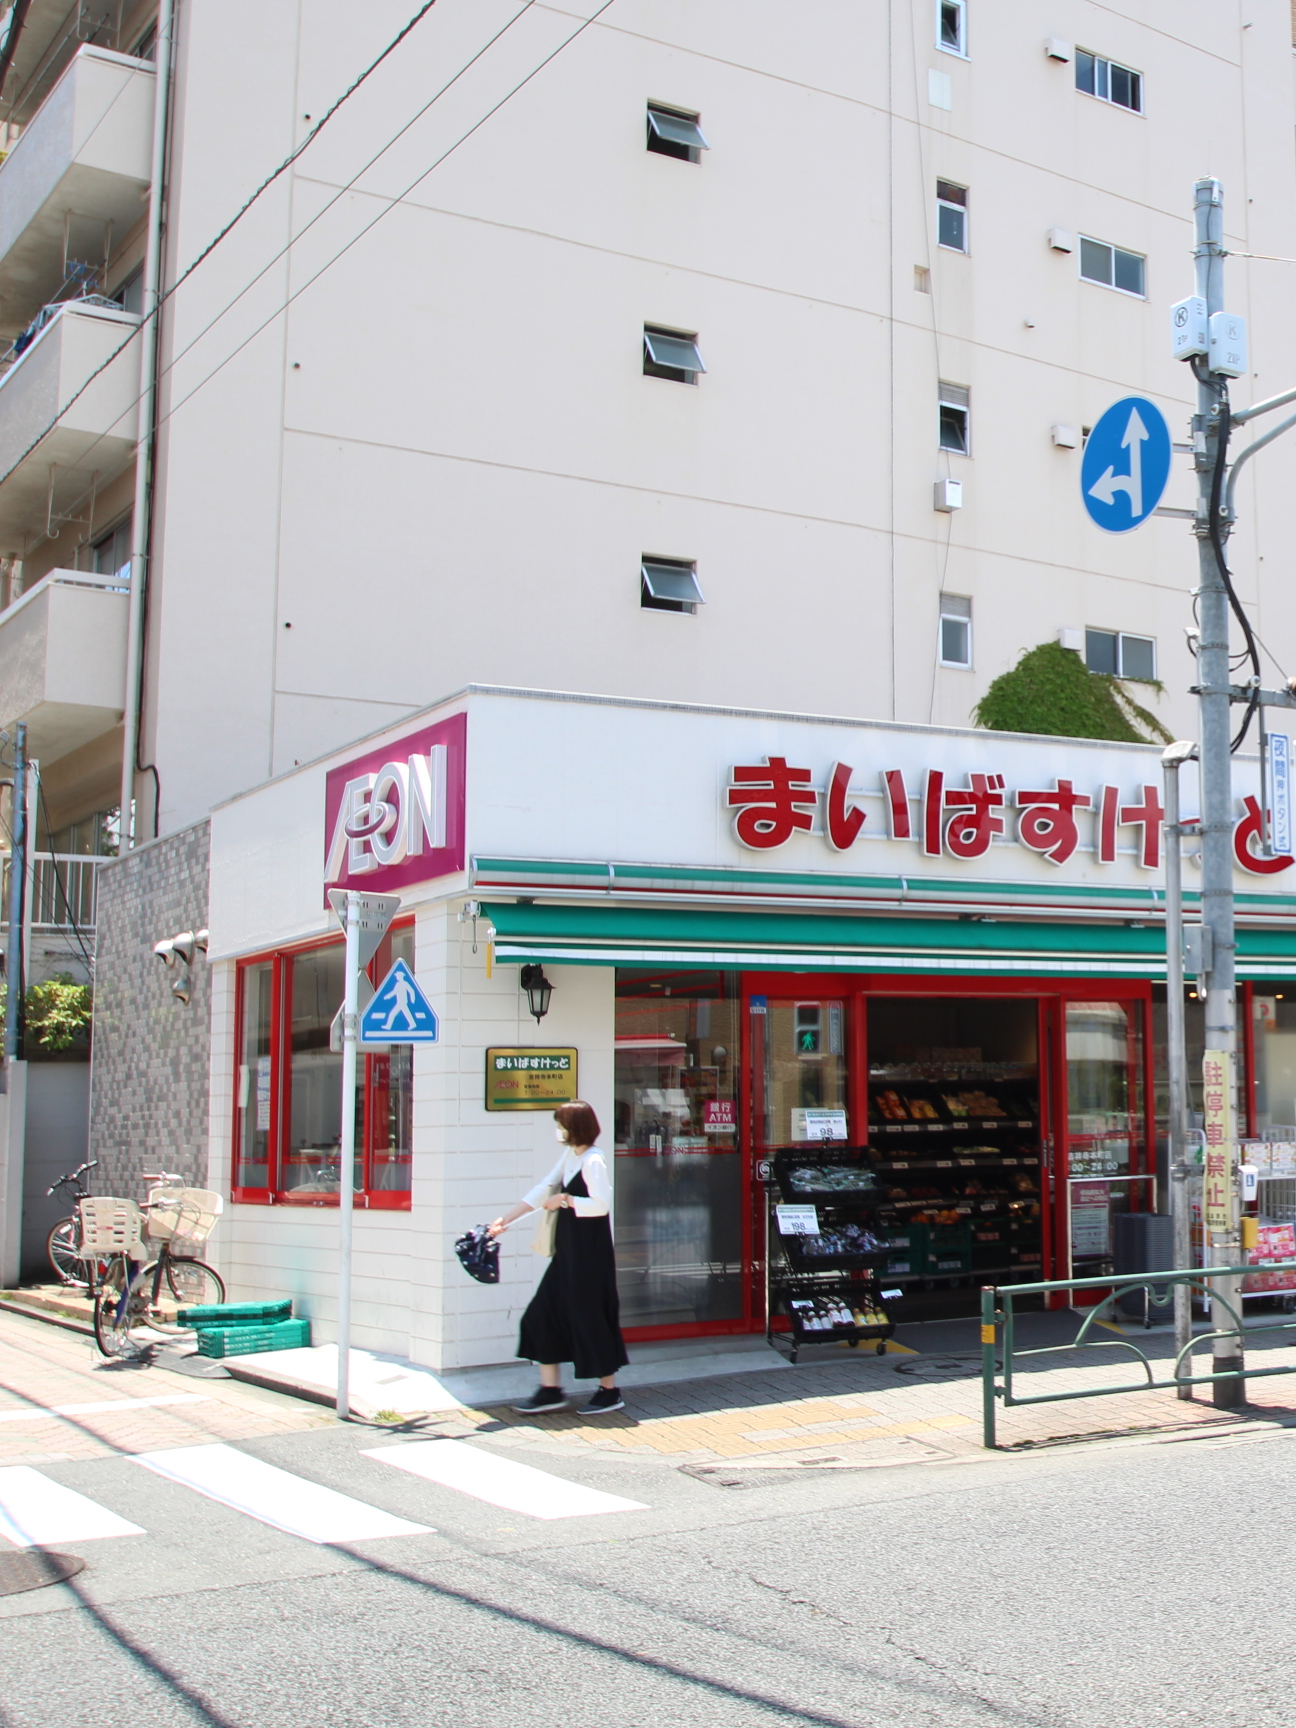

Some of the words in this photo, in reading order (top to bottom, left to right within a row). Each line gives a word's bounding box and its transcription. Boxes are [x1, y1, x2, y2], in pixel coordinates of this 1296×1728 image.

[725, 755, 1296, 877] まいばすけと
[495, 1057, 569, 1070] まいばすけっと
[709, 1102, 731, 1113] 銀行
[709, 1113, 732, 1122] ATM
[819, 1127, 834, 1136] 98
[1205, 1061, 1226, 1208] 駐停車禁止
